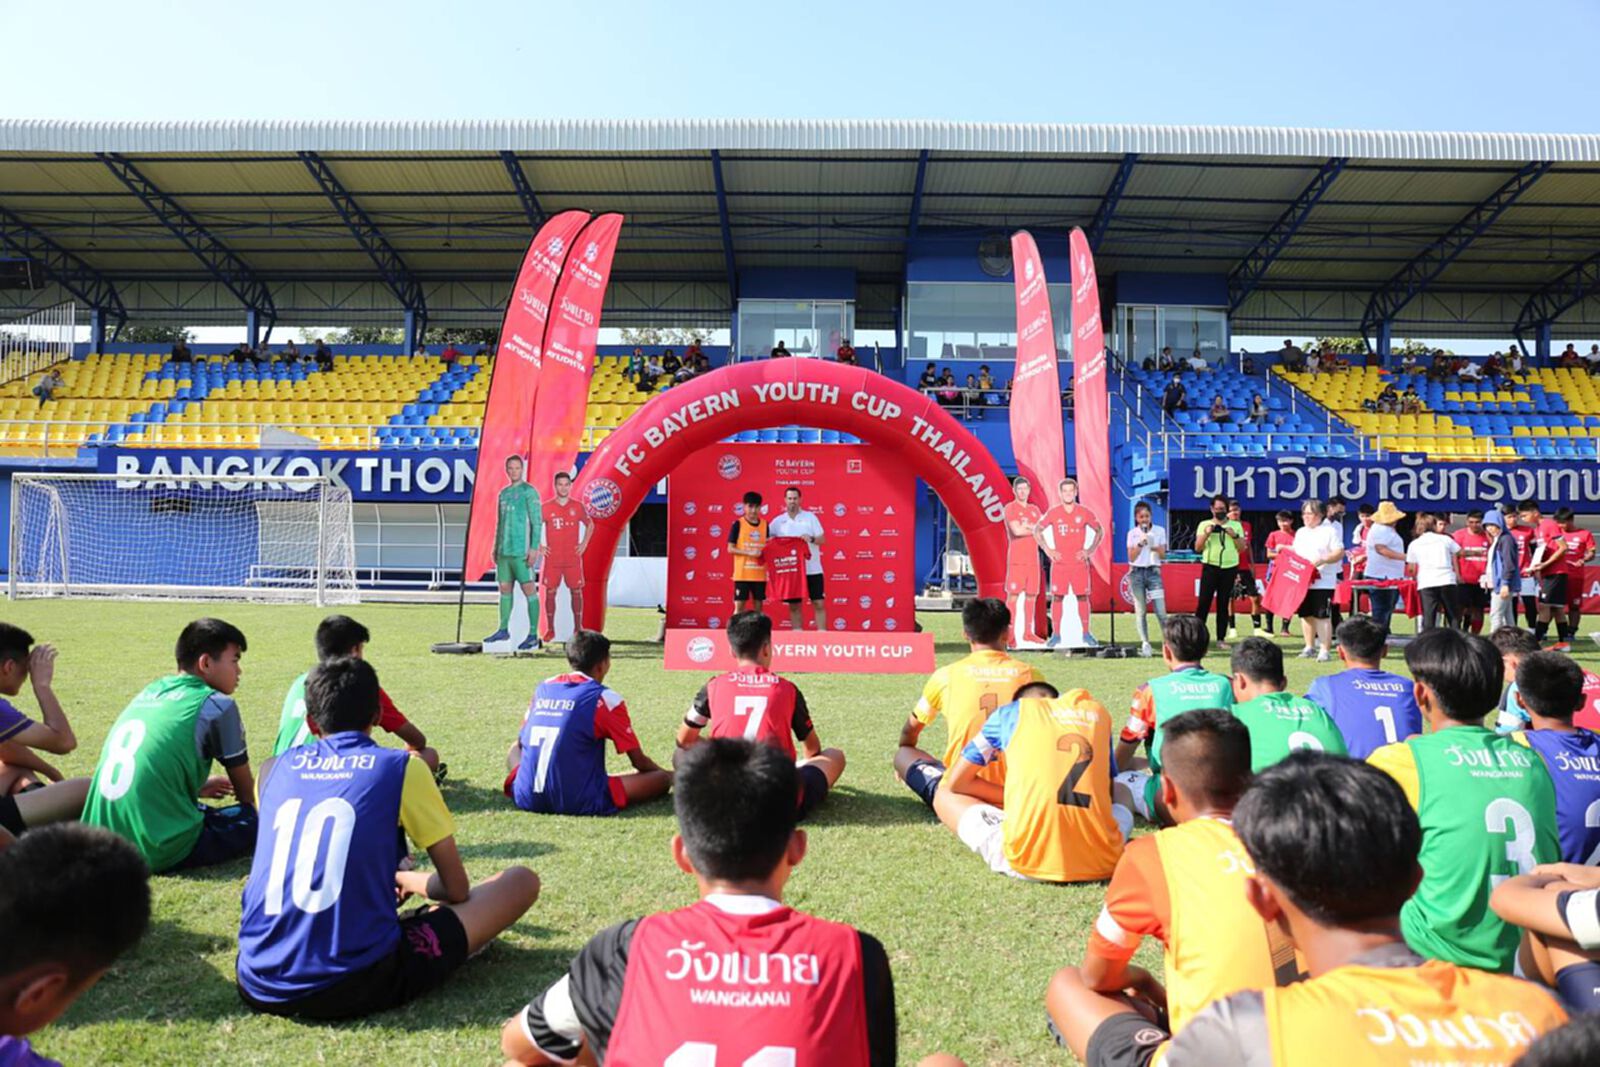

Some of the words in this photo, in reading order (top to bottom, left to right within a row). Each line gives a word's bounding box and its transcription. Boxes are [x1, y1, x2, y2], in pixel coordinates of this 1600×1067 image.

[116, 455, 351, 491] BANGKOK
[355, 457, 477, 493] THON
[614, 443, 646, 477] FC
[643, 388, 740, 448] BAYERN
[751, 381, 840, 404] YOUTH
[851, 390, 901, 420] CUP
[909, 415, 1005, 524] THAILAND
[773, 644, 817, 657] YERN
[823, 644, 876, 657] YOUTH
[881, 644, 913, 657] CUP
[734, 695, 769, 742] 7
[99, 718, 147, 801] 8
[291, 750, 376, 771] วังขนาย
[529, 726, 560, 793] 7
[1056, 733, 1094, 808] 2
[265, 797, 356, 915] 10
[1485, 797, 1538, 891] 3
[665, 940, 819, 985] วังขนาย
[689, 988, 791, 1007] WANGKANAI
